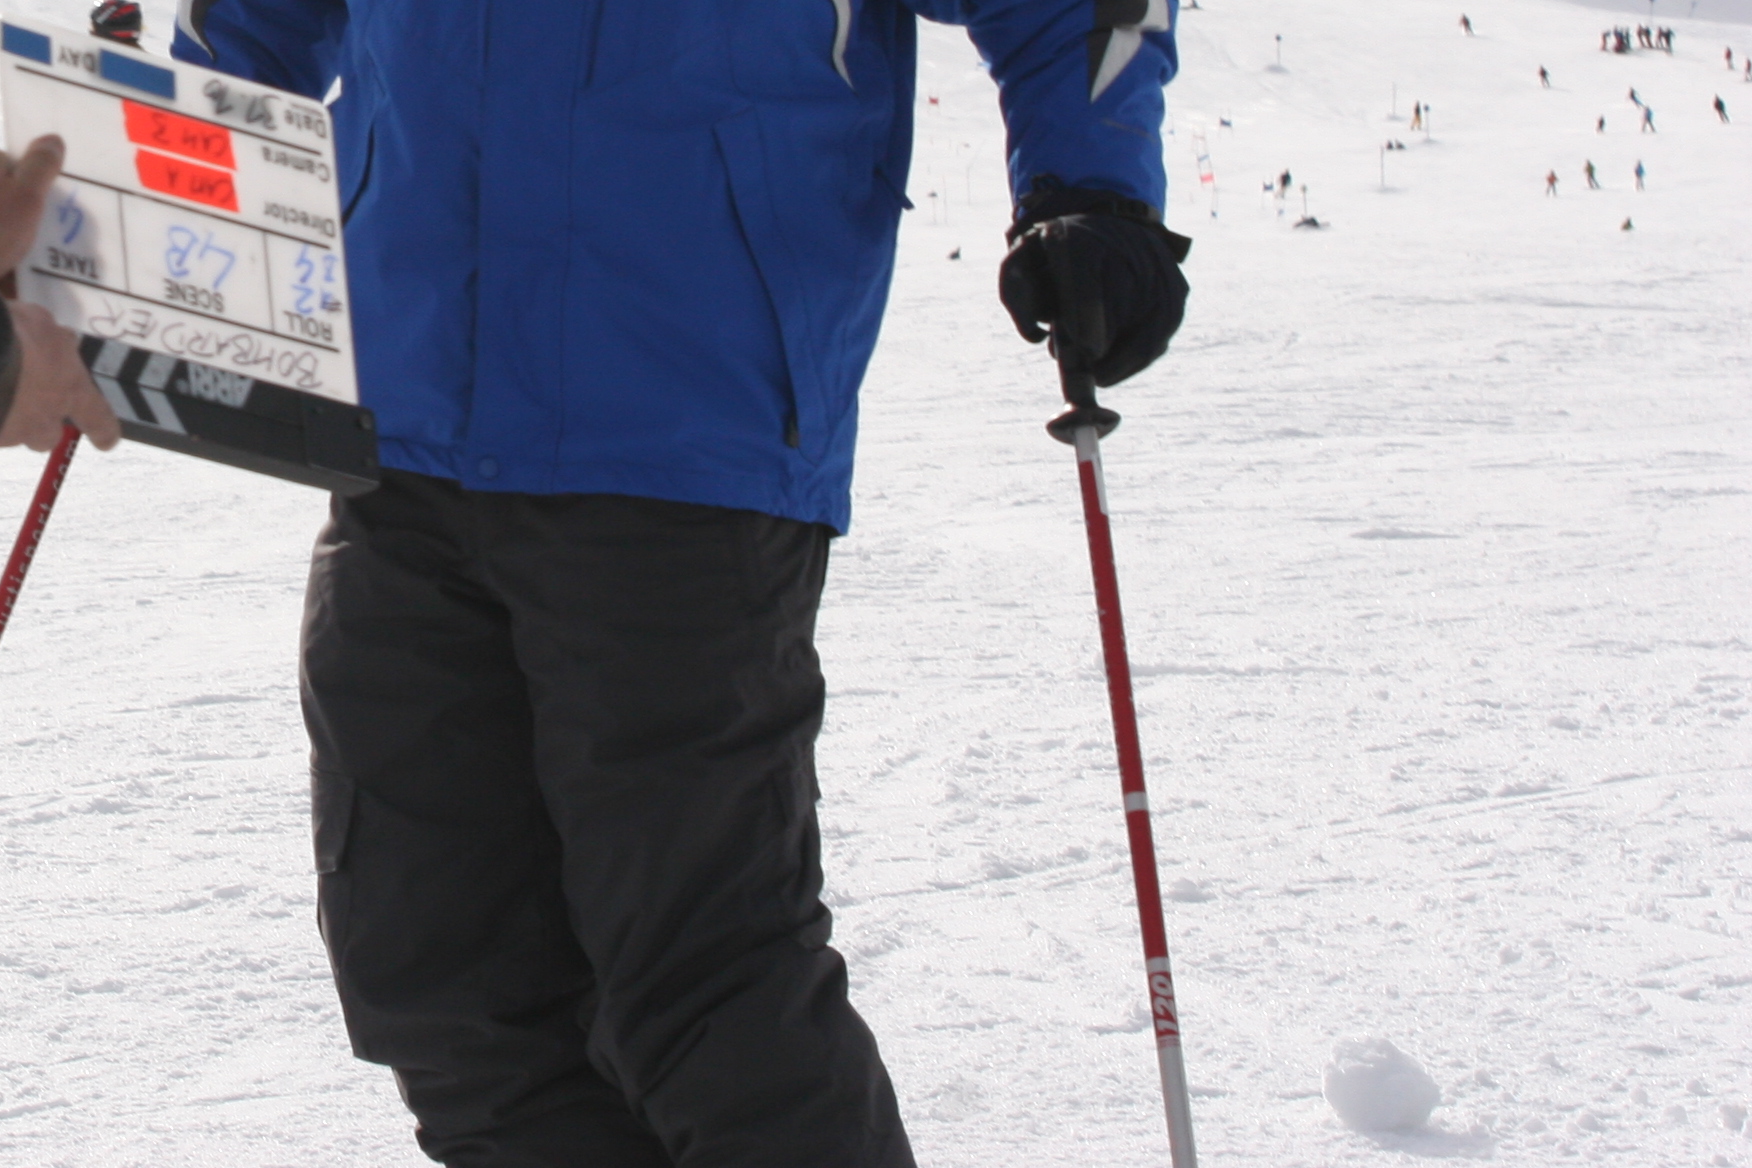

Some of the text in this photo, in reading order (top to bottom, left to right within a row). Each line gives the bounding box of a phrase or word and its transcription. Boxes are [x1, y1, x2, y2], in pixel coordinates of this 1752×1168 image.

[58, 45, 97, 74] DAY
[285, 109, 327, 139] Date
[262, 146, 331, 183] Camera
[263, 201, 336, 239] Director
[47, 247, 100, 280] TAKE
[164, 278, 226, 314] SCENE
[283, 310, 334, 343] ROLL
[187, 363, 255, 409] ARRI
[1150, 974, 1180, 1036] 120
